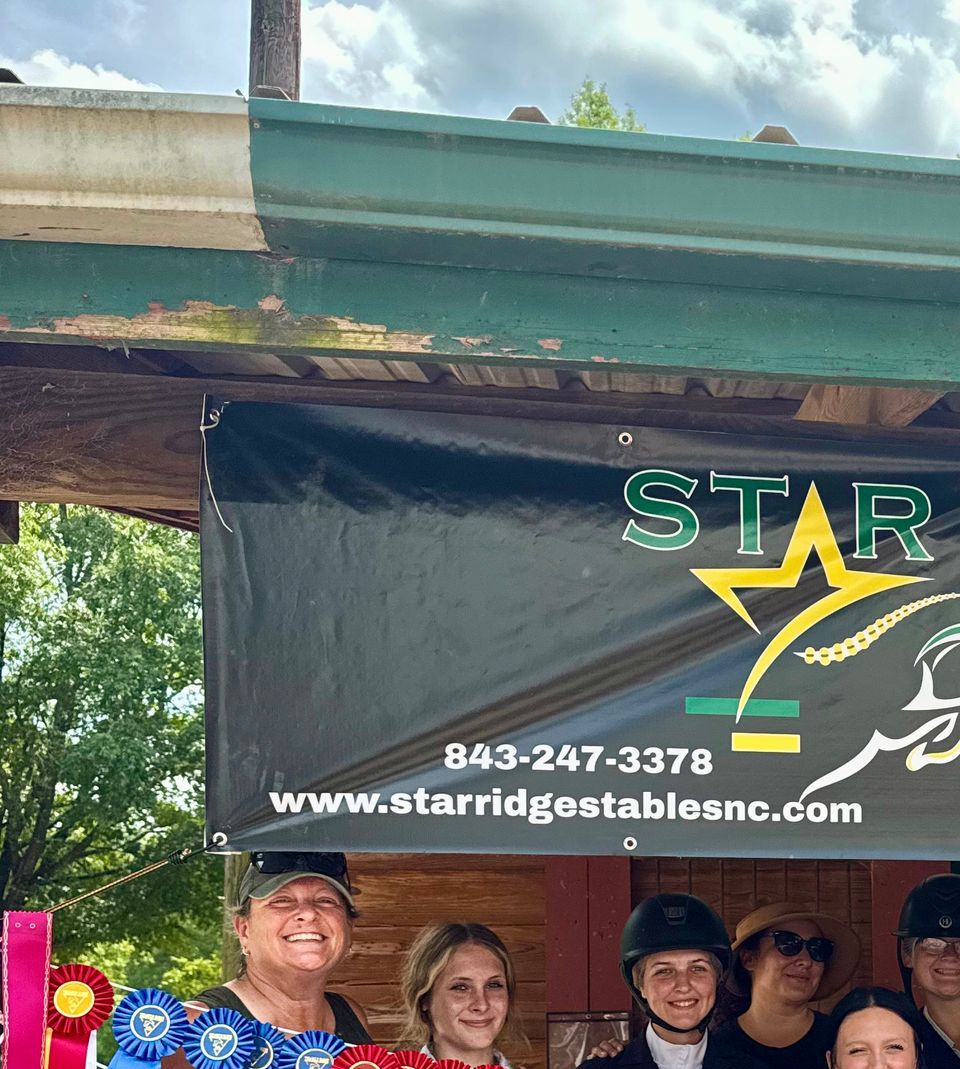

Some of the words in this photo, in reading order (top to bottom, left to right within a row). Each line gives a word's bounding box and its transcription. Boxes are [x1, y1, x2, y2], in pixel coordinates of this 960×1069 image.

[622, 469, 934, 561] STAR
[444, 742, 712, 775] 843-247-3378
[270, 787, 862, 824] www.starridgestablesnc.com
